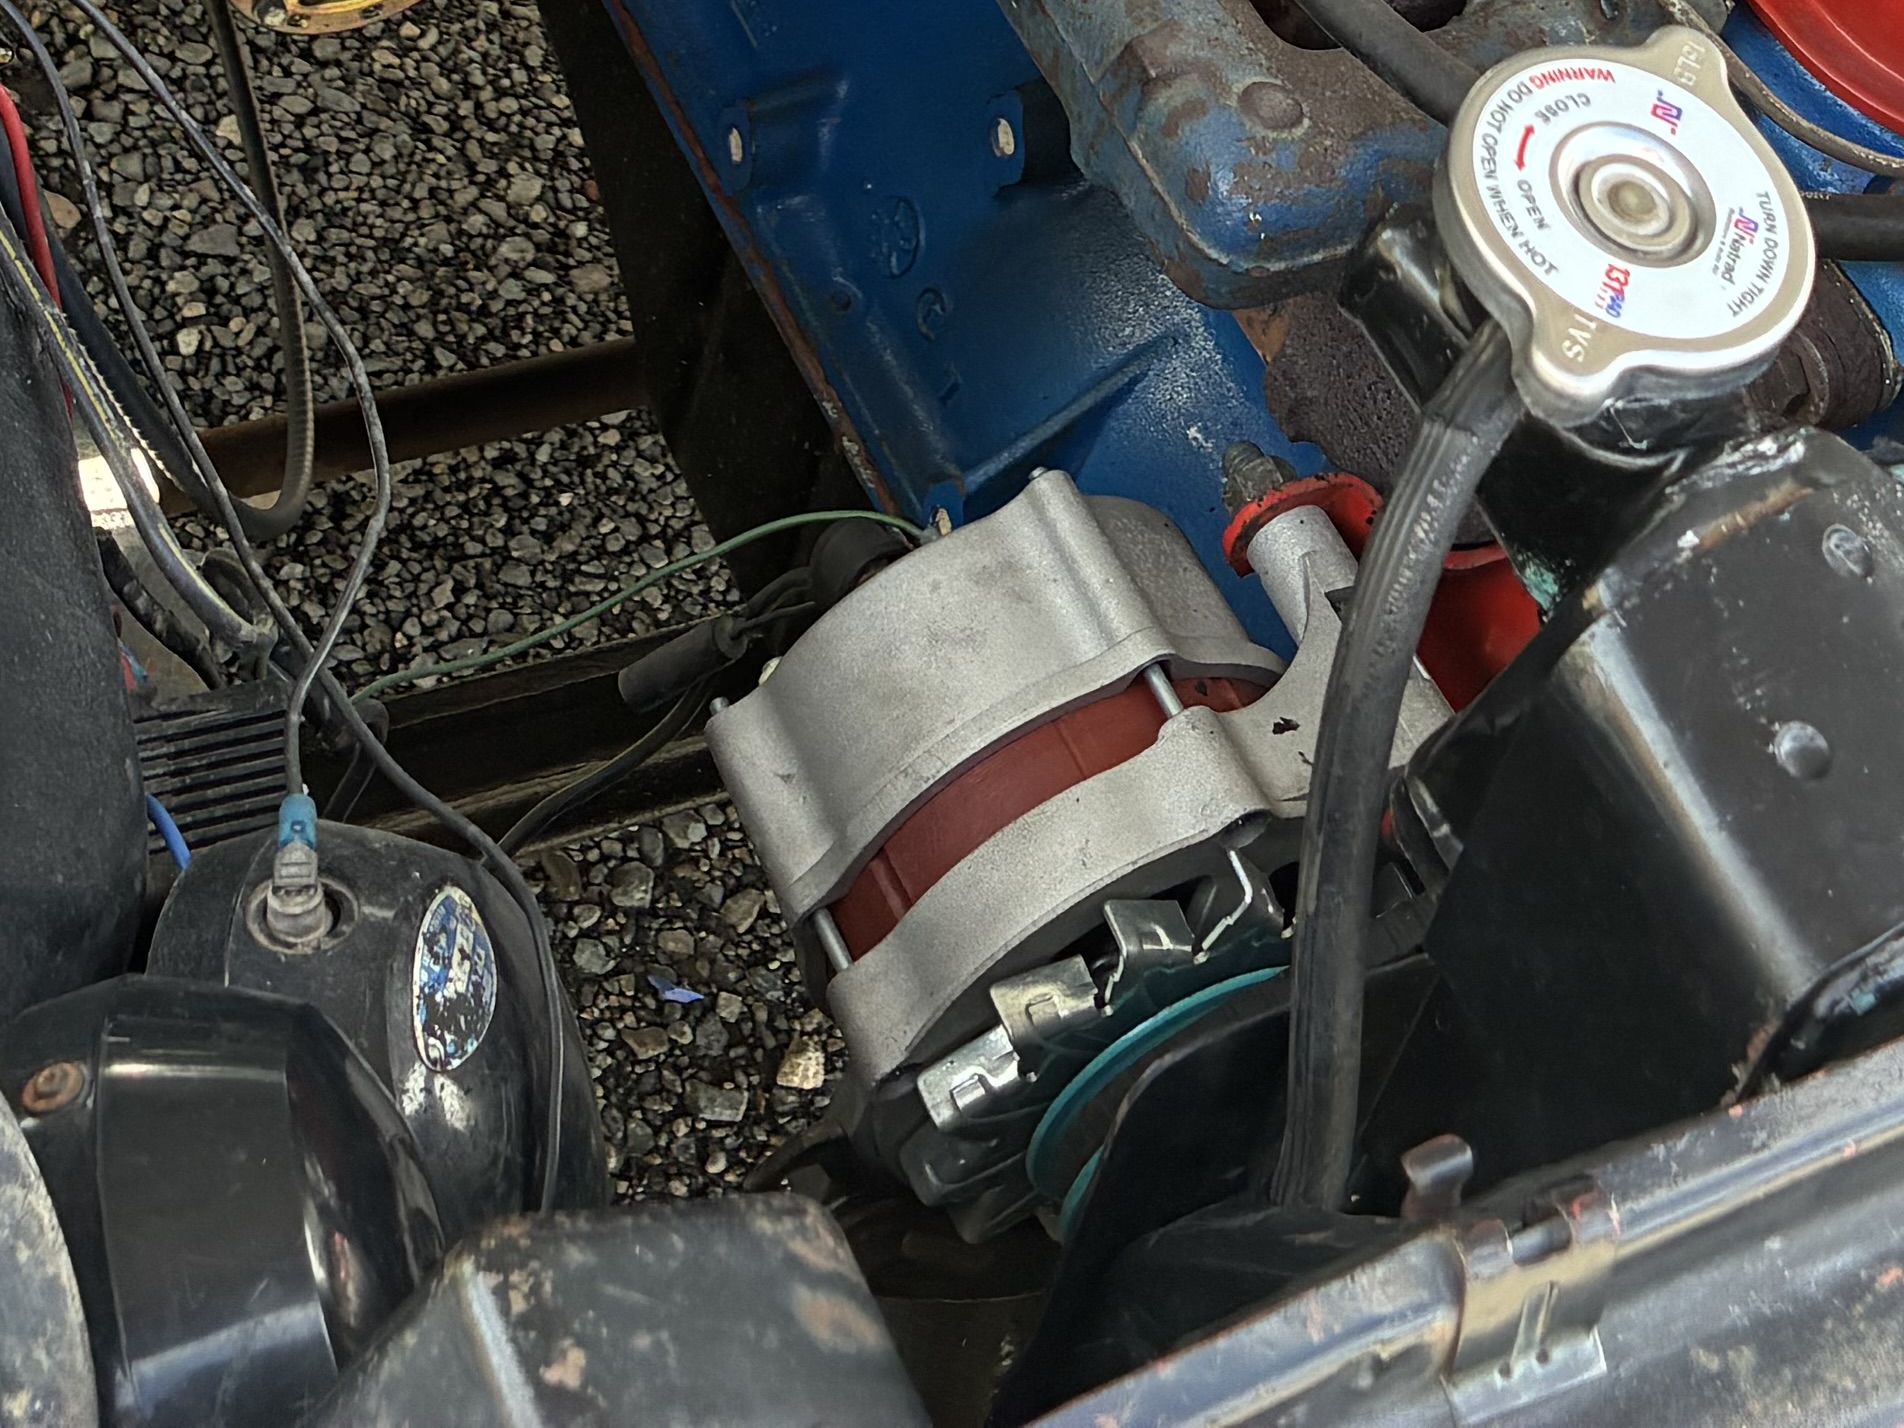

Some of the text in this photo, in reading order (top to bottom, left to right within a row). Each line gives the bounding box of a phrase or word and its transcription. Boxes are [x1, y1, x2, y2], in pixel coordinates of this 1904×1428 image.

[1534, 92, 1592, 125] CLOSE
[1480, 67, 1616, 276] WARNING DO NOT OPEN WHEN HOT
[1517, 178, 1551, 233] OPEN
[1721, 231, 1747, 285] Natrad
[1726, 191, 1779, 318] TURN DOWN TIGHT
[1562, 314, 1597, 362] TVS
